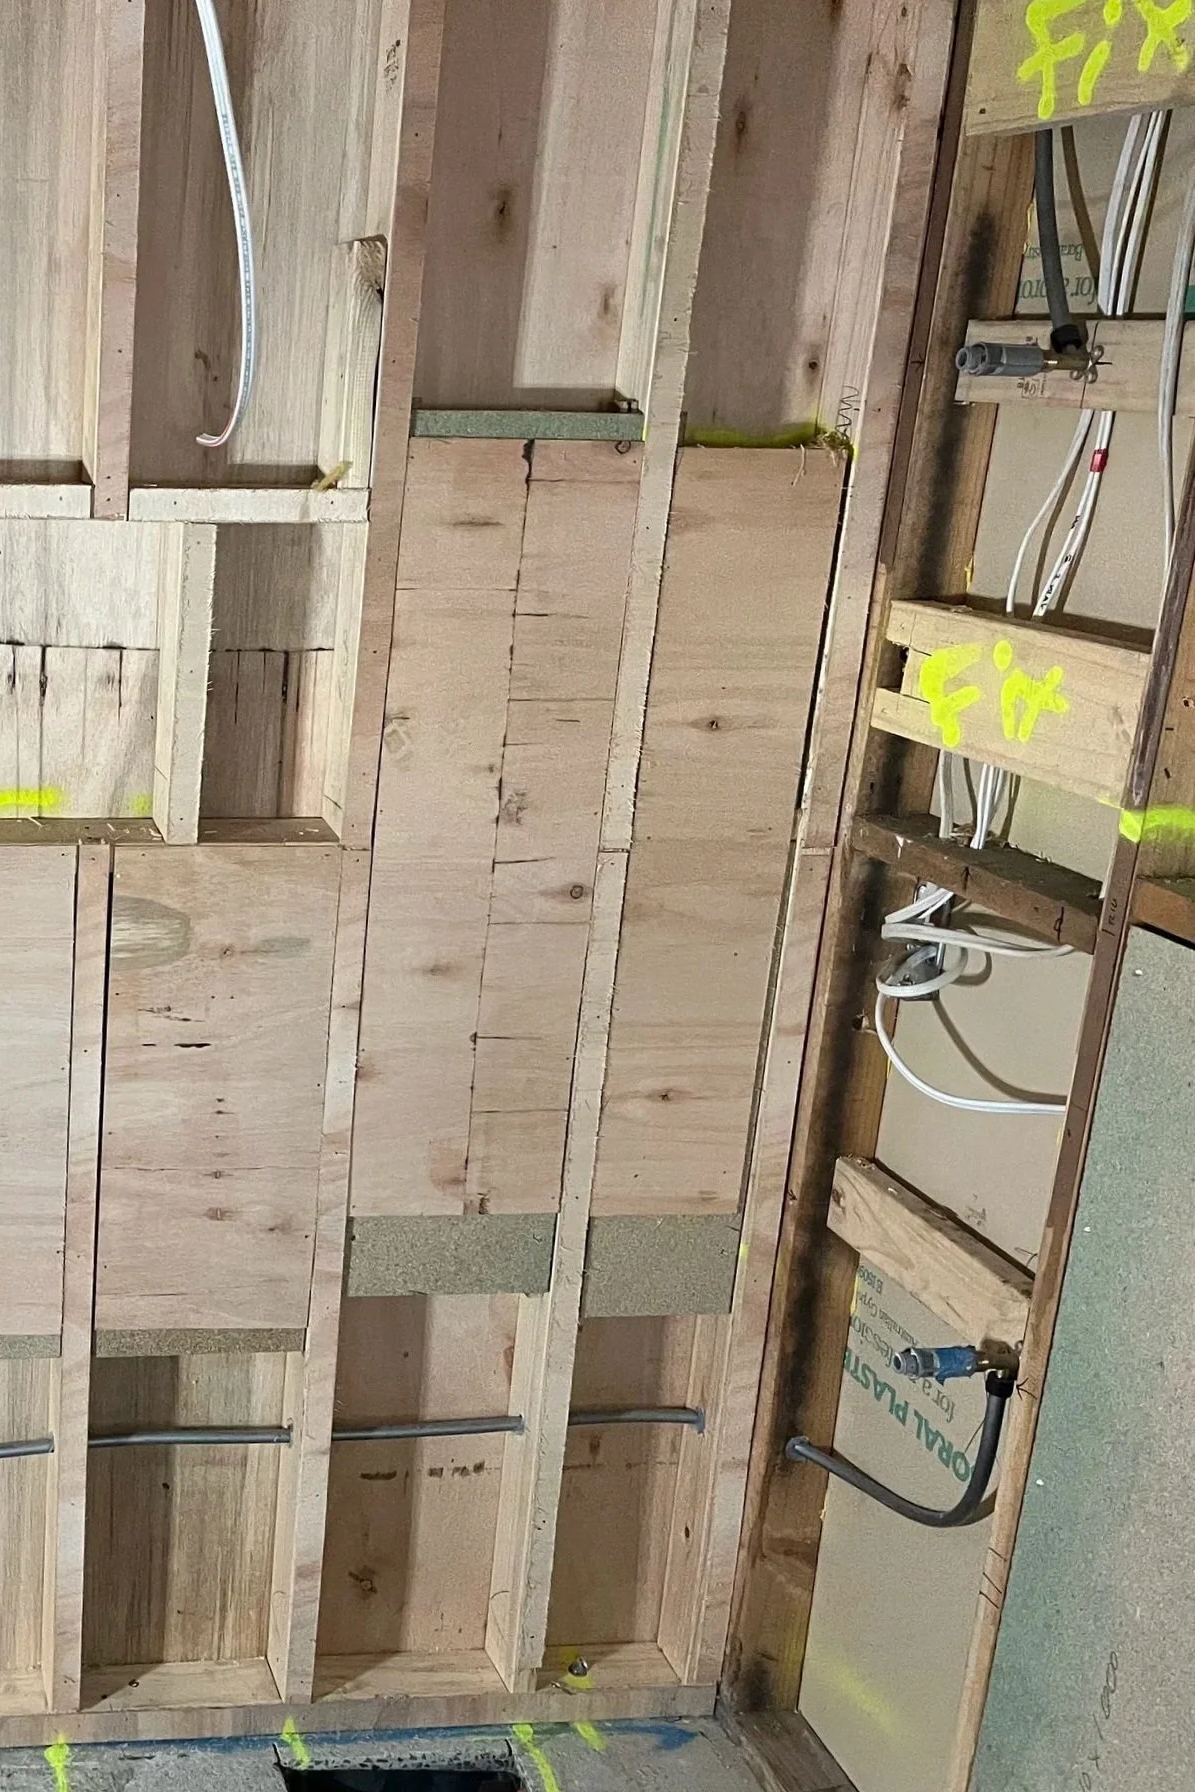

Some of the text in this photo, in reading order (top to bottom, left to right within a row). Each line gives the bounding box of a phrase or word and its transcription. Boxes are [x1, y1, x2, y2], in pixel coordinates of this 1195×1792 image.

[922, 1378, 932, 1396] a
[932, 1389, 955, 1423] for
[913, 1408, 973, 1482] ORAL
